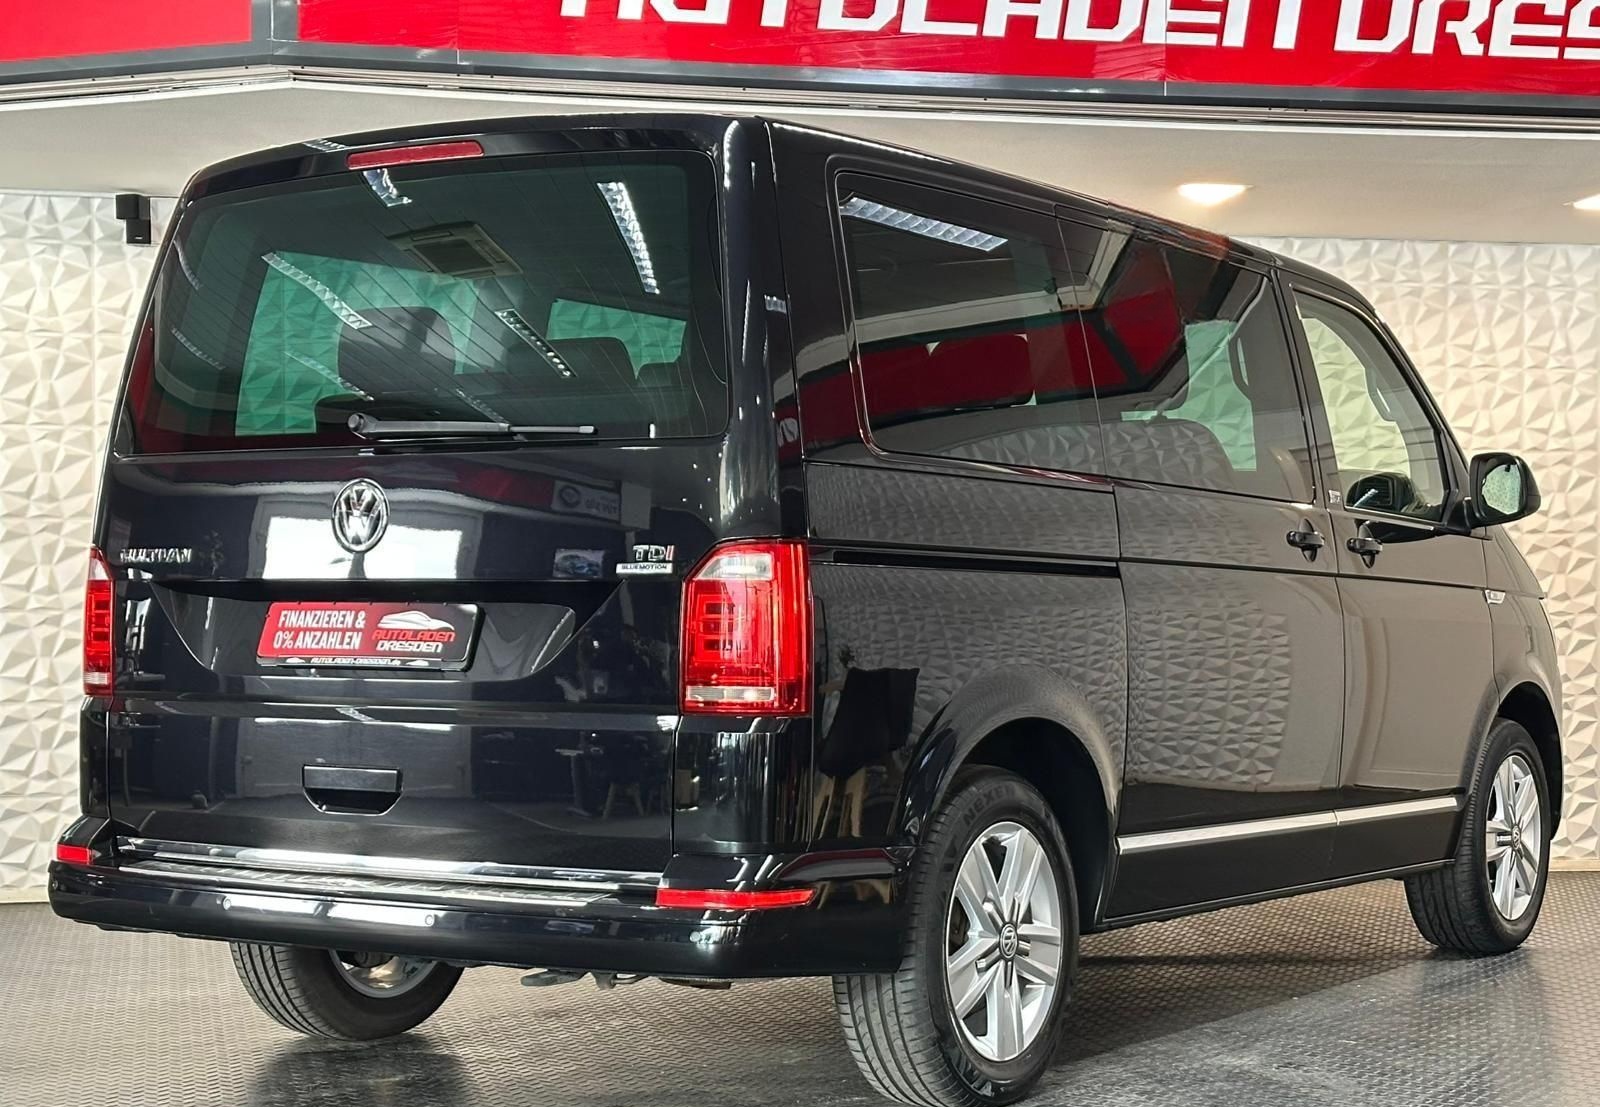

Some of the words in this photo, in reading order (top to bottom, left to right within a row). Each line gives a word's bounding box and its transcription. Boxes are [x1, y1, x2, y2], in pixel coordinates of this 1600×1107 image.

[632, 544, 675, 561] TDI
[278, 610, 355, 628] FINANZIEREN
[354, 610, 366, 628] &
[273, 632, 294, 649] 0%
[294, 632, 362, 650] ANZAHLEN
[372, 628, 456, 643] AUTOLADEN
[376, 640, 443, 653] DRESDEN
